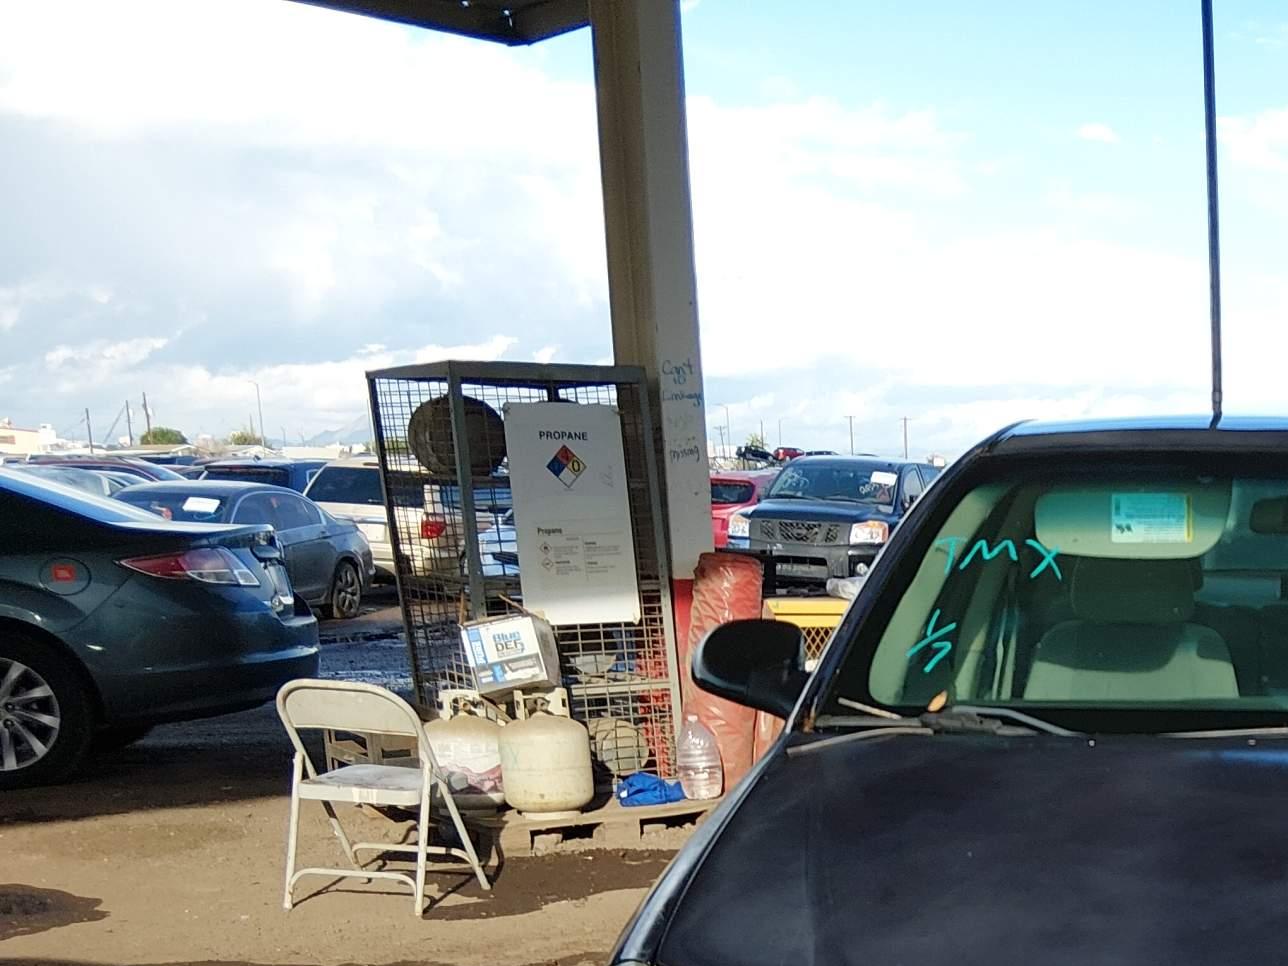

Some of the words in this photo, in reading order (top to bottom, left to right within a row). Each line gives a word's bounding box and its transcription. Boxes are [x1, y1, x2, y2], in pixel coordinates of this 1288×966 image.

[538, 430, 589, 441] PROPANE
[571, 459, 581, 473] 0
[935, 536, 1063, 582] TMX
